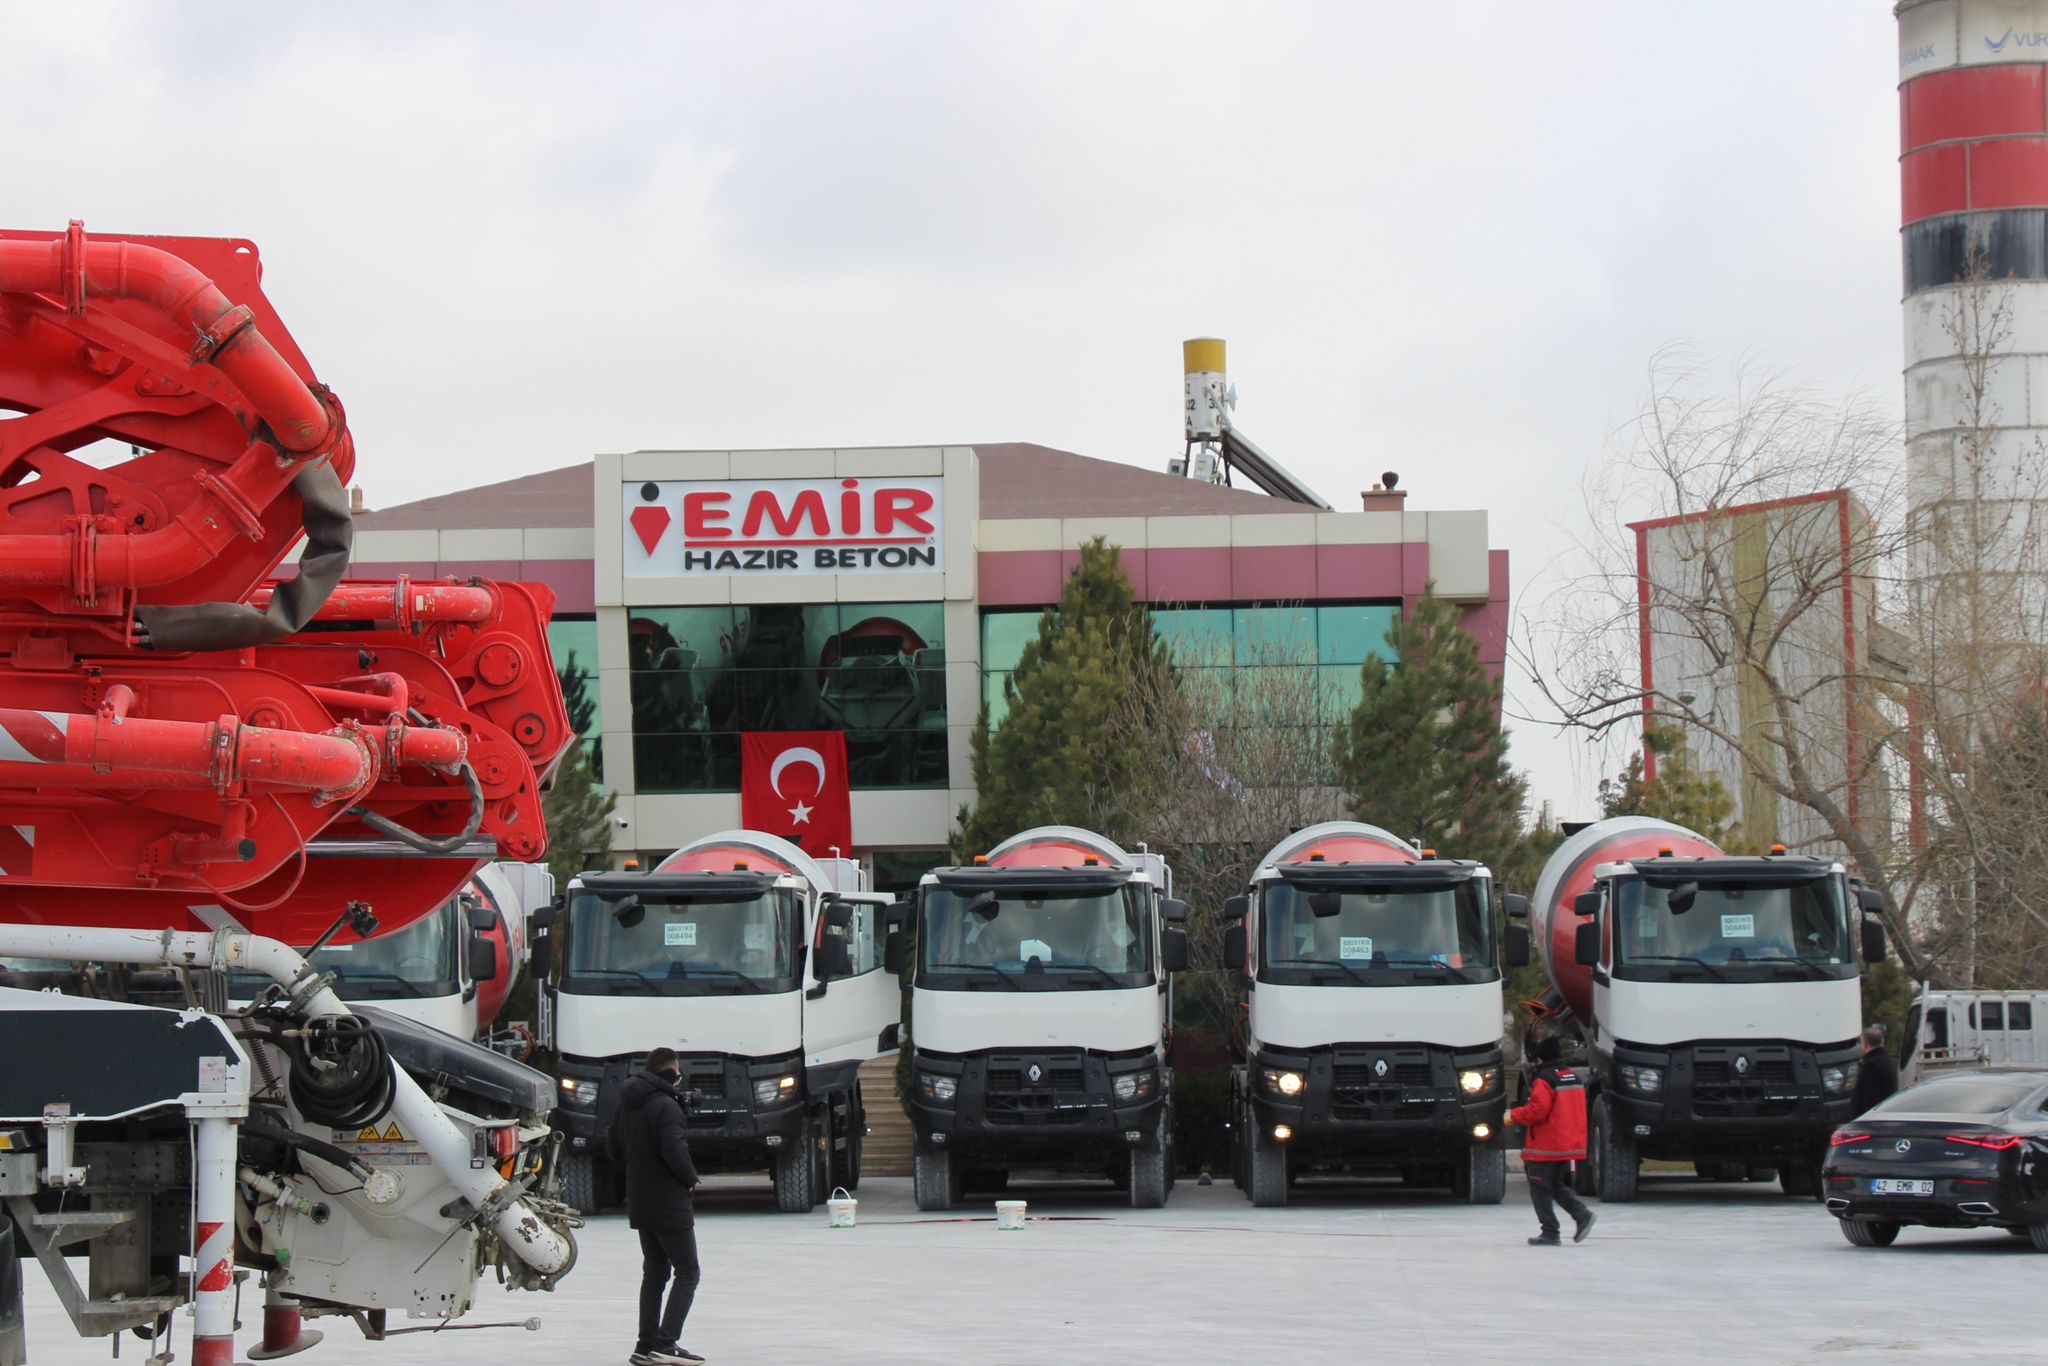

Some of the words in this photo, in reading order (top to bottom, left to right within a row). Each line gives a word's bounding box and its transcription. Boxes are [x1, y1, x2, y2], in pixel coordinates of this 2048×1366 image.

[684, 478, 935, 538] EMİR
[684, 549, 799, 571] HAZIR
[814, 546, 936, 569] BETON
[1876, 1180, 1888, 1191] 42
[1896, 1181, 1914, 1192] EMR
[1921, 1182, 1933, 1192] 02
